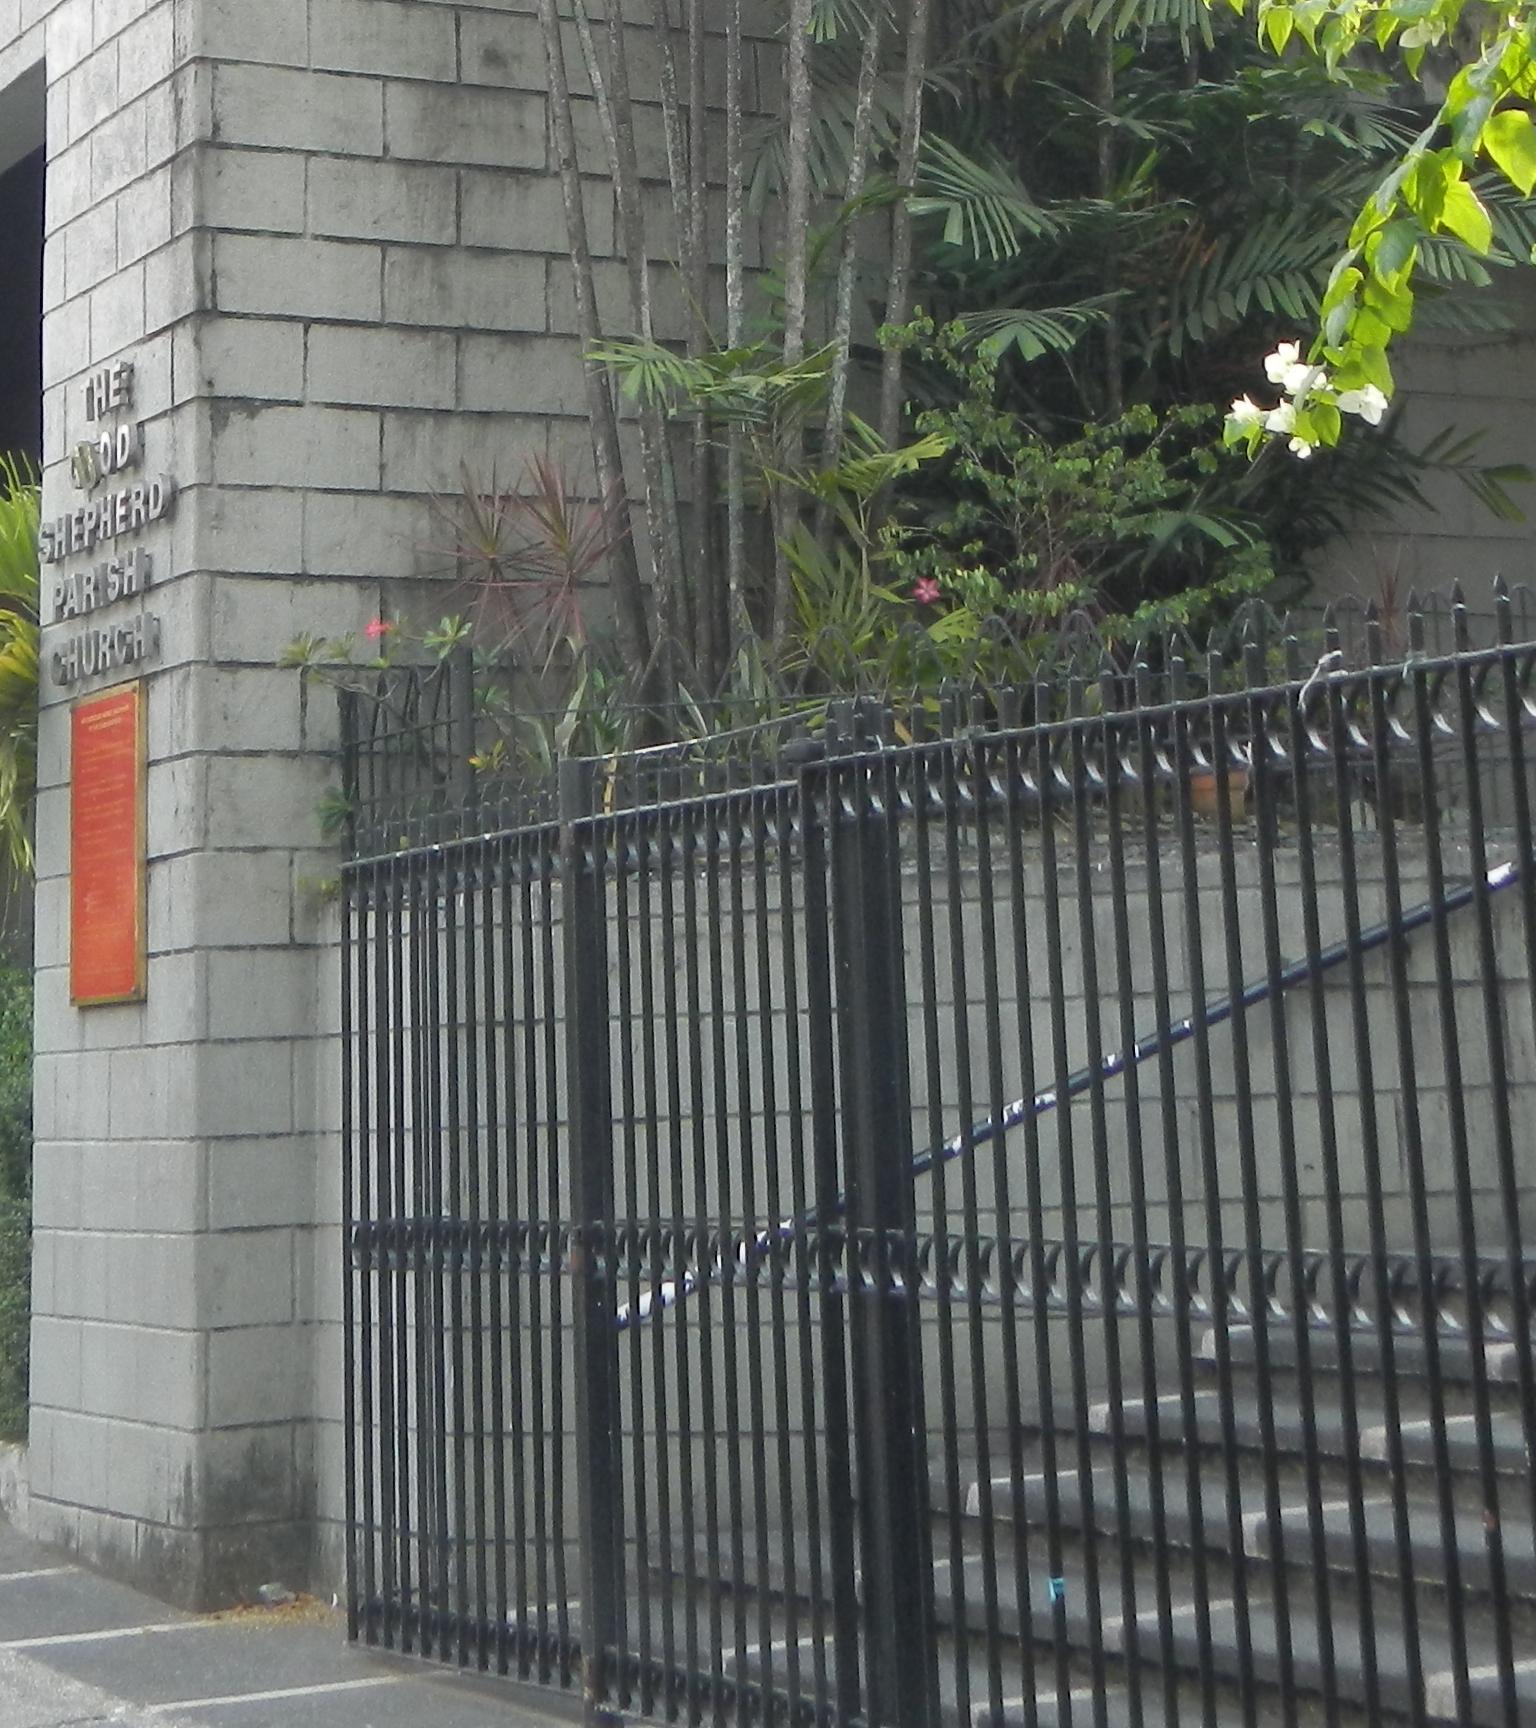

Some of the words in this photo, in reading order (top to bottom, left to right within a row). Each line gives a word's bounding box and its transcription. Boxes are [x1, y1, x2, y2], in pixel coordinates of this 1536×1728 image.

[80, 362, 132, 422] THE
[38, 474, 169, 563] SHEPHERD
[52, 547, 144, 620] PARISH
[50, 613, 152, 684] CHURCH
